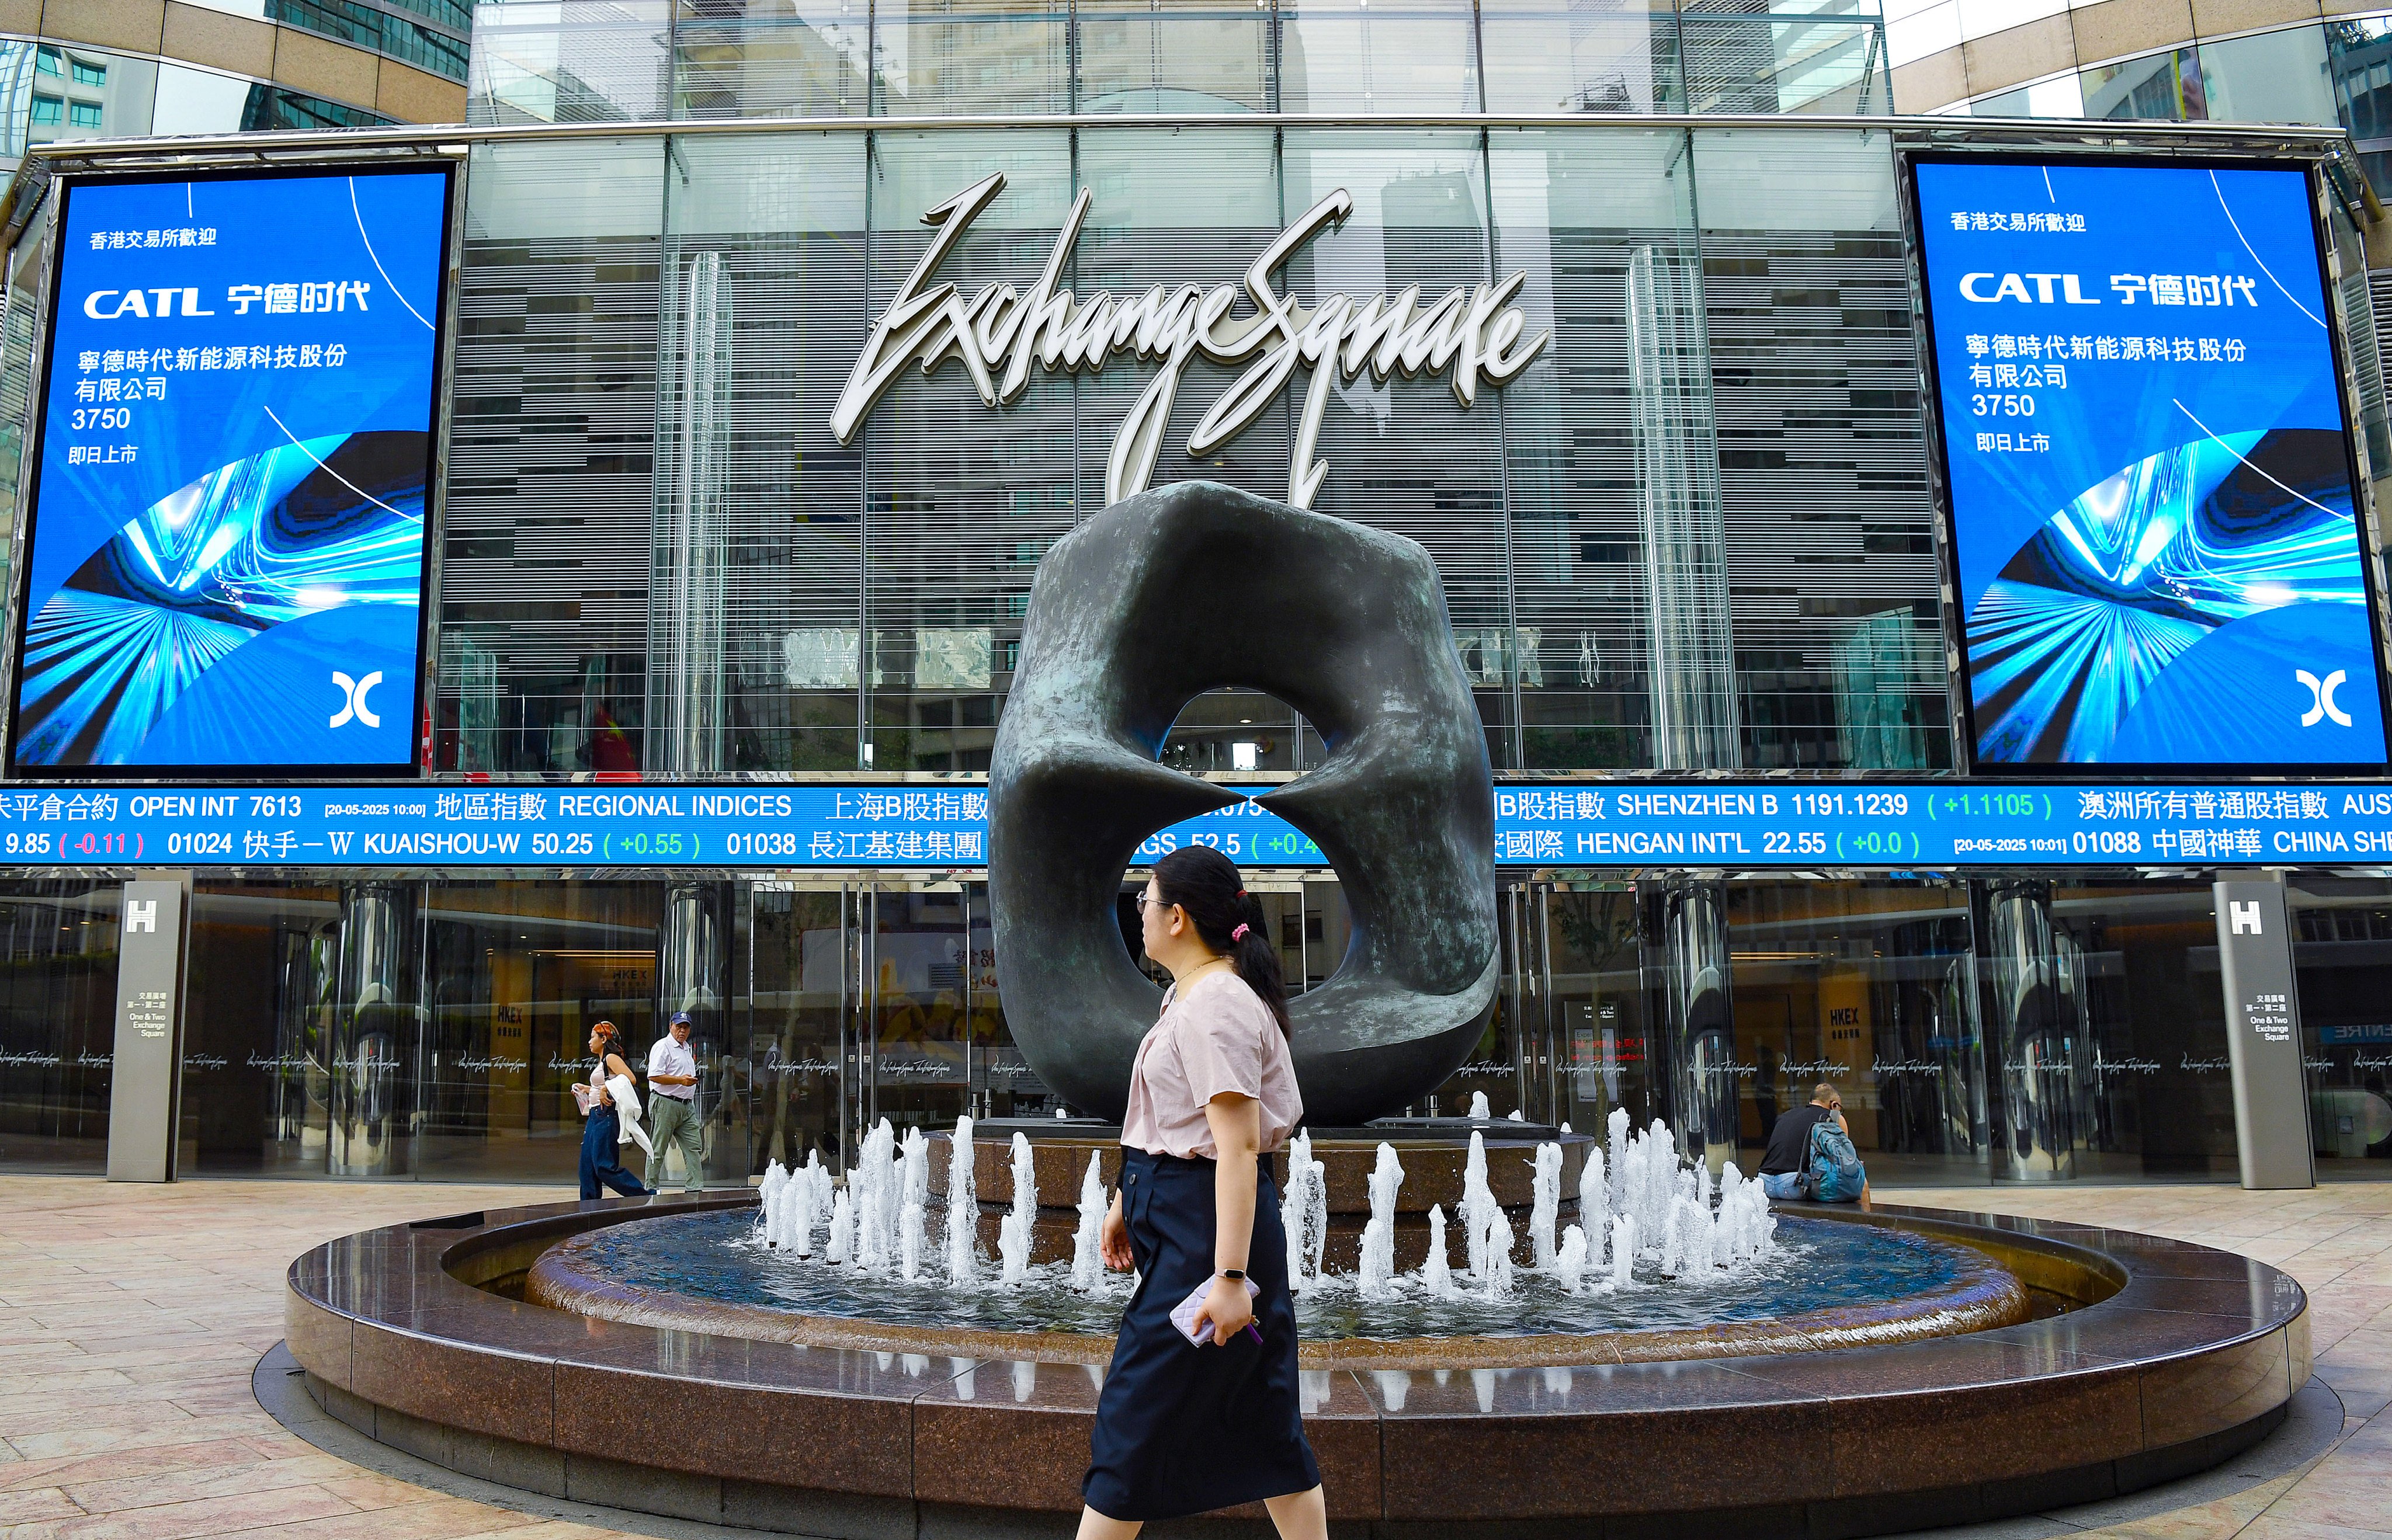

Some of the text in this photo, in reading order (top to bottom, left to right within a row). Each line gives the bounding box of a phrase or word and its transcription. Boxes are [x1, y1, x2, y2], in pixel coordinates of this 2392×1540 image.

[1951, 212, 2086, 232] 香港交易所歡迎
[90, 228, 217, 250] 香港交易所歡迎
[84, 280, 370, 319] CATL 宁德时代
[1960, 273, 2258, 307] CATL 宁德时代
[829, 170, 1550, 510] Exchange Square
[1966, 334, 2247, 362] 寧德時代新能源科技股份
[78, 343, 348, 374] 寧德時代新能源科技股份
[1969, 363, 2067, 389] 有限公司
[74, 377, 166, 403] 有限公司
[1972, 394, 2035, 416] 3750
[71, 407, 130, 430] 3750
[1976, 432, 2050, 453] 即日上市
[68, 444, 138, 465] 即日上市
[130, 796, 196, 817] OPEN
[202, 796, 240, 816] INT
[249, 795, 301, 817] 7613
[324, 792, 792, 821] [20-05-2025 10:00] 地區指數 REGIONAL INDICES
[825, 792, 988, 822] 上海B股指數
[1494, 791, 1606, 821] B股指數
[1617, 794, 1755, 816] SHENZHEN
[1762, 794, 1779, 815] B
[1792, 794, 1908, 816] 1191.1239
[1945, 794, 2034, 816] +1.1105
[2078, 790, 2392, 820] 澳洲所有普通股指數 AUS
[5, 833, 51, 854] 9.85
[74, 833, 126, 854] -0.11
[168, 832, 233, 854] 01024
[364, 832, 521, 854] KUAISHOU-W
[532, 833, 593, 855] 50.25
[620, 833, 683, 854] +0.55
[727, 830, 981, 860] 01038 長江基建集團
[1577, 832, 1684, 854] HENGAN
[1691, 832, 1751, 853] INT'L
[1763, 832, 1827, 854] 22.55
[1853, 832, 1902, 854] +0.0
[1953, 839, 2027, 855] [20-05-2025
[2030, 839, 2067, 855] 10:01]
[2072, 831, 2141, 854] 01088
[2153, 828, 2263, 858] 中國神華
[2273, 831, 2350, 853] CHINA
[129, 1013, 166, 1021] One & Two
[133, 1021, 165, 1030] Exchange
[2250, 1016, 2288, 1024] One & Two
[141, 1029, 165, 1038] Square
[2255, 1024, 2289, 1034] Exchange
[2265, 1033, 2290, 1042] Square
